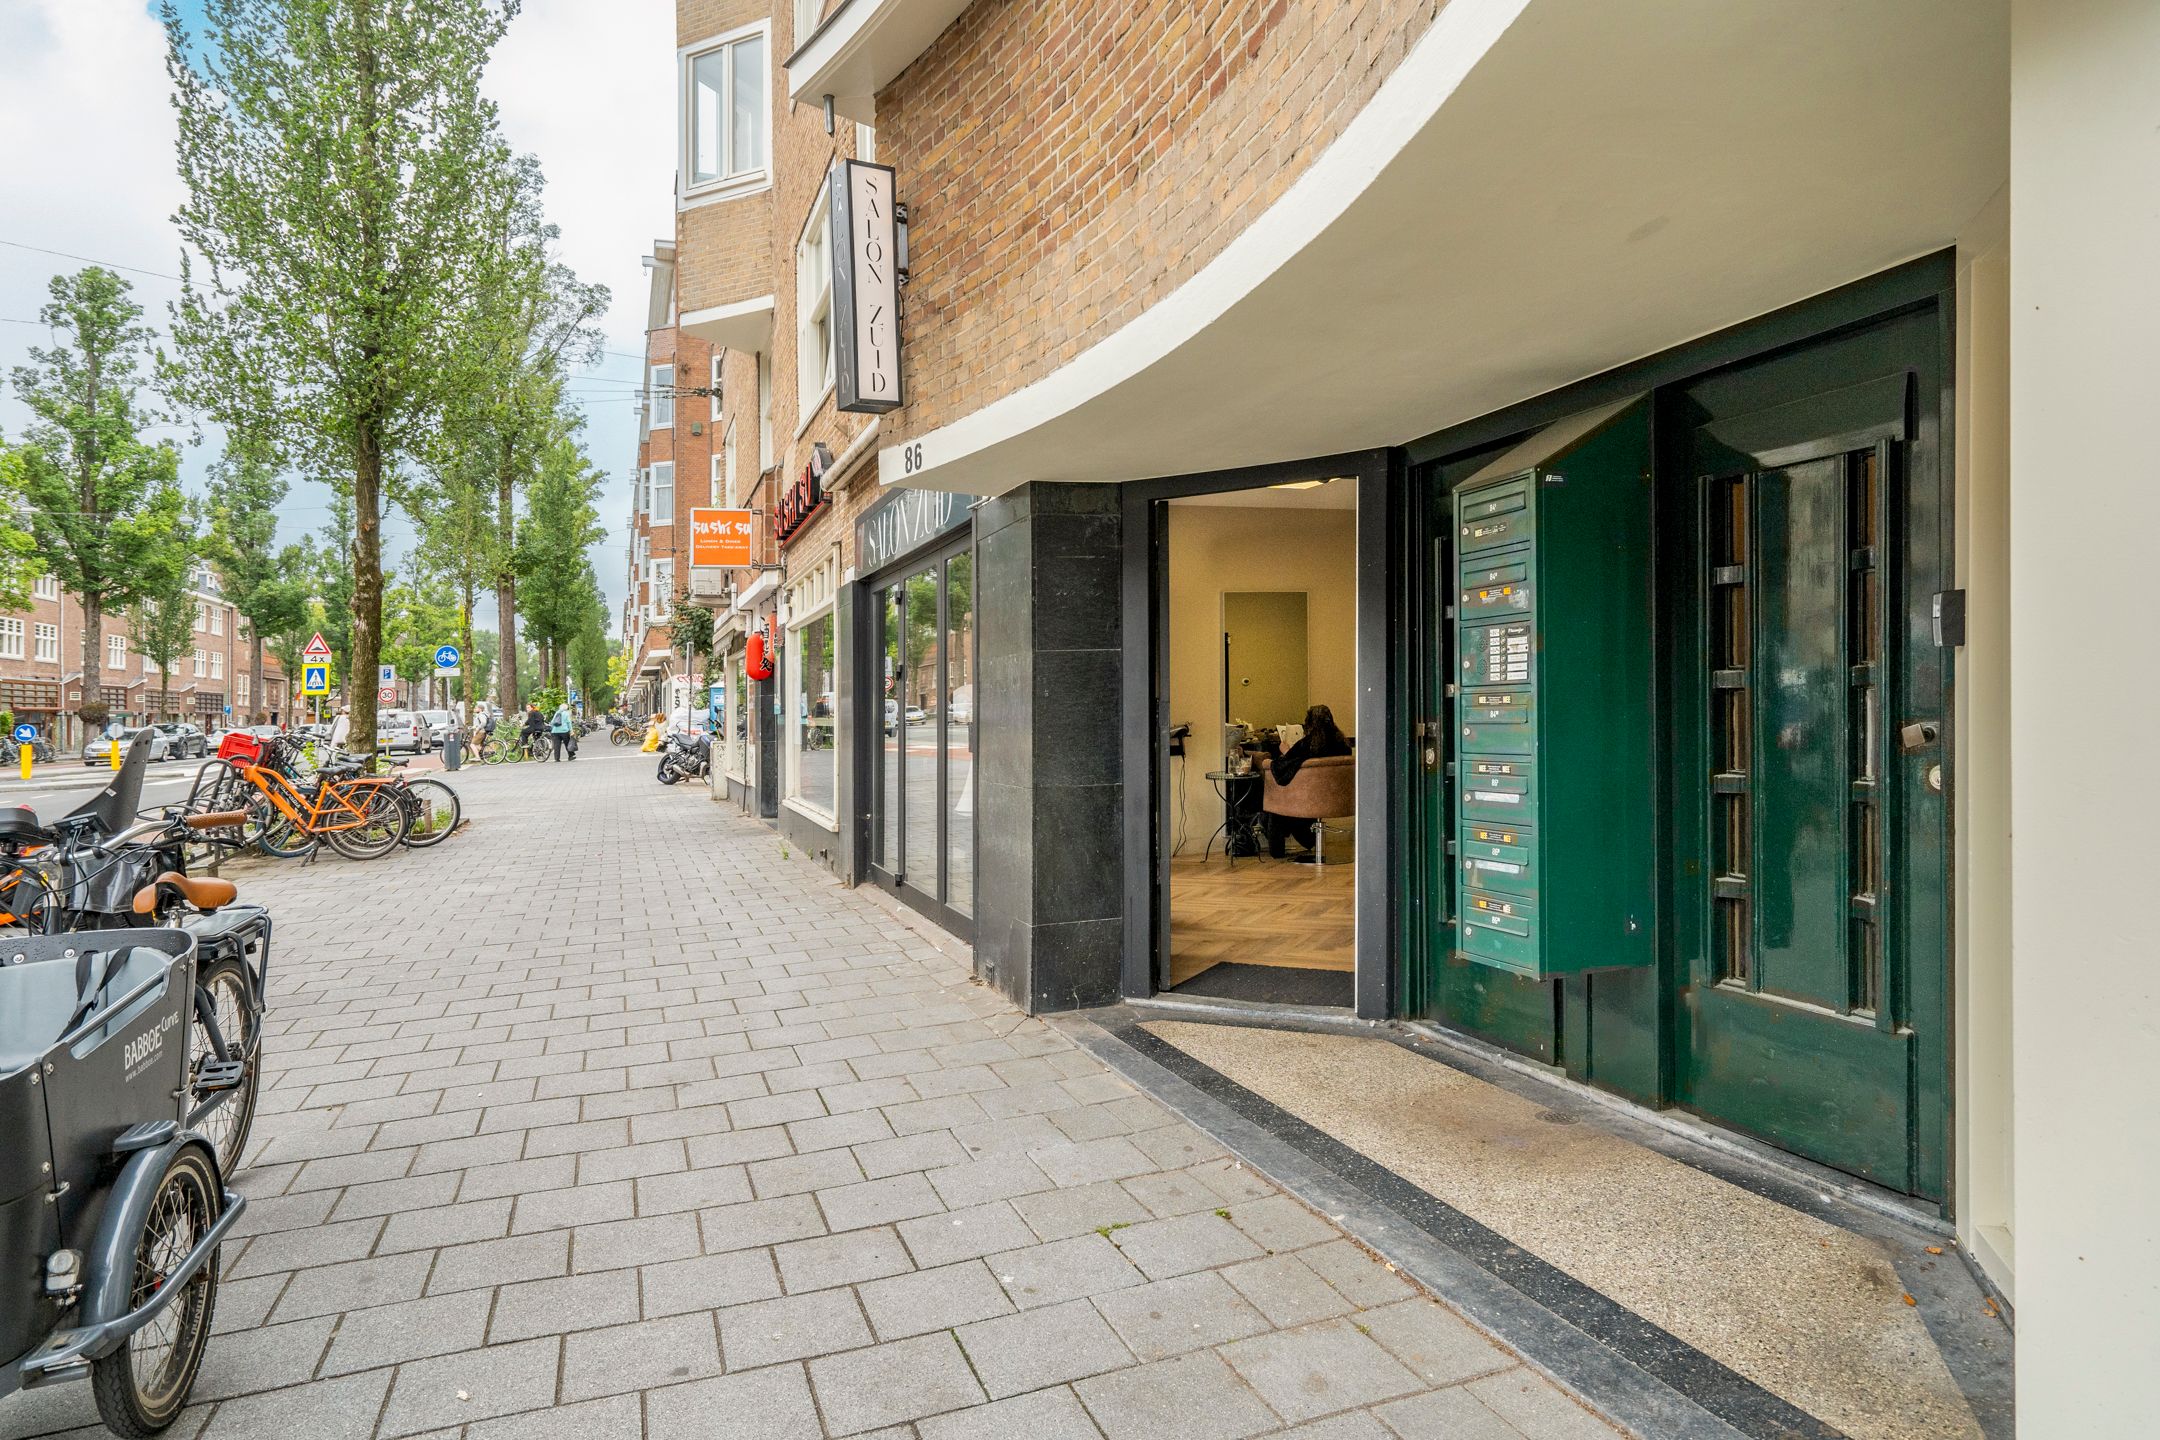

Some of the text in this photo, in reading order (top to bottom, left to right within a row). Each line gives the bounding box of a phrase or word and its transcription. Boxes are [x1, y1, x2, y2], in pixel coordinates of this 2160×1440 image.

[865, 175, 886, 393] SALON ZUID
[904, 443, 922, 474] 86
[693, 520, 751, 535] sushi su
[125, 1024, 163, 1071] BABBOE
